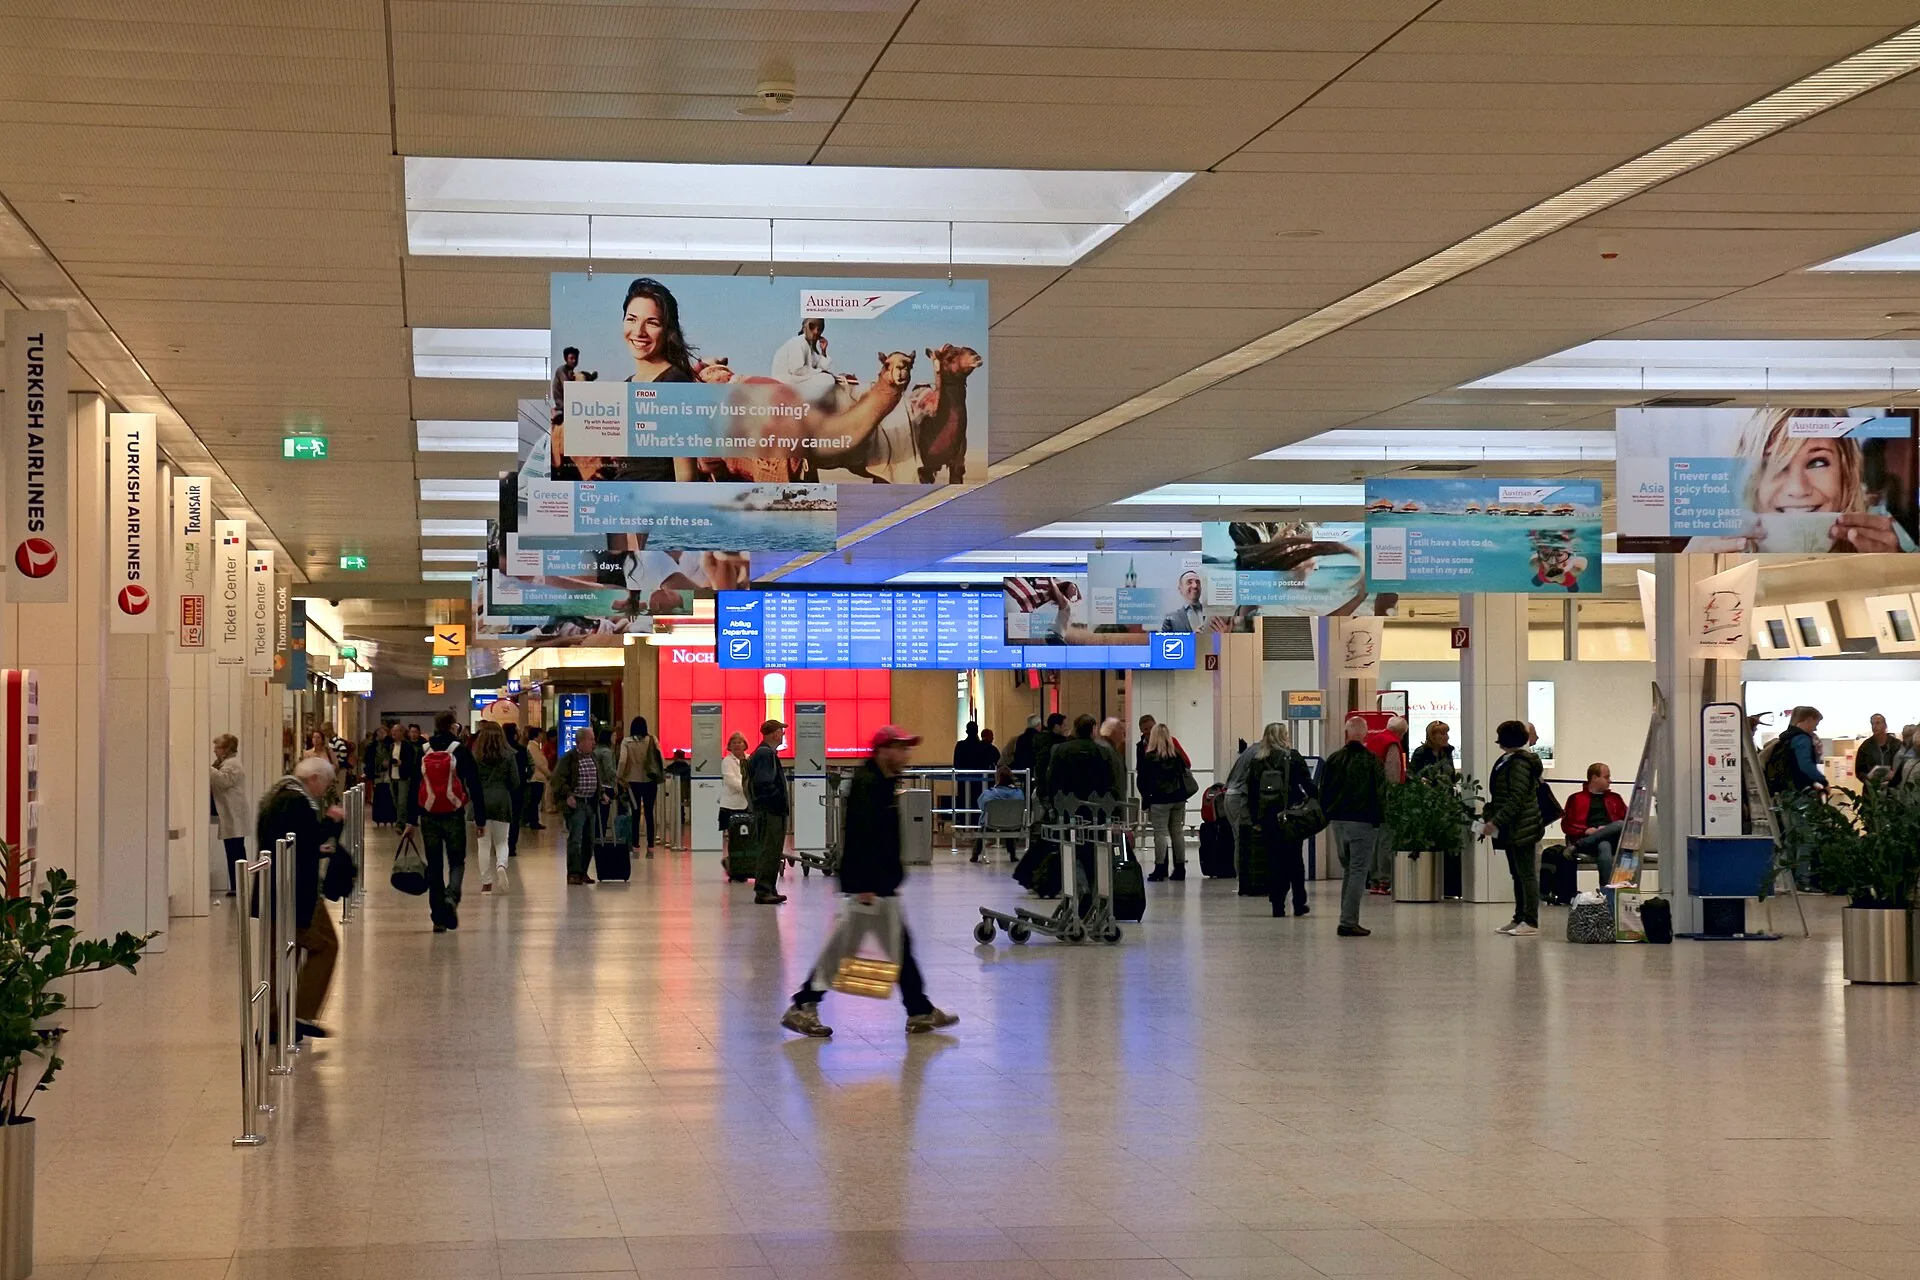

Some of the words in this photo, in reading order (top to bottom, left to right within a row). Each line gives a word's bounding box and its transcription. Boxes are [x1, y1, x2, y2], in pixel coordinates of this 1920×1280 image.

[806, 296, 859, 307] Austrian
[27, 333, 44, 428] TURKISH
[572, 401, 620, 416] Dubai
[635, 402, 677, 414] When
[681, 402, 692, 414] is
[696, 405, 717, 418] my
[720, 403, 746, 416] bus
[750, 403, 810, 419] coming?
[635, 434, 684, 447] What's
[686, 434, 712, 447] the
[716, 438, 756, 448] name
[759, 435, 775, 448] of
[778, 438, 798, 450] my
[802, 436, 852, 448] camel?
[127, 431, 139, 503] TURKISH
[27, 432, 44, 532] AIRLINES
[1674, 472, 1677, 480] I
[533, 490, 568, 500] Greece
[1640, 483, 1664, 493] Asia
[1674, 484, 1700, 495] spicy
[1702, 484, 1730, 493] food.
[580, 492, 600, 504] City
[602, 492, 620, 502] air.
[1674, 507, 1694, 516] Can
[1696, 508, 1715, 518] you
[1718, 508, 1740, 518] pass
[580, 516, 600, 525] The
[602, 516, 618, 525] air
[620, 516, 654, 526] tastes
[656, 516, 668, 526] of
[670, 516, 689, 526] the
[691, 518, 713, 526] sea.
[1692, 520, 1710, 528] the
[1712, 520, 1742, 528] chilli?
[127, 506, 140, 580] AIRLINES
[186, 551, 194, 589] JAHN
[600, 562, 622, 572] days.
[224, 556, 237, 598] Center
[255, 582, 265, 619] Center
[277, 587, 287, 612] Cook
[185, 600, 194, 624] BILLA
[224, 604, 237, 644] Ticket
[189, 628, 198, 643] ITS
[255, 622, 265, 656] Ticket
[277, 613, 287, 652] Thomas
